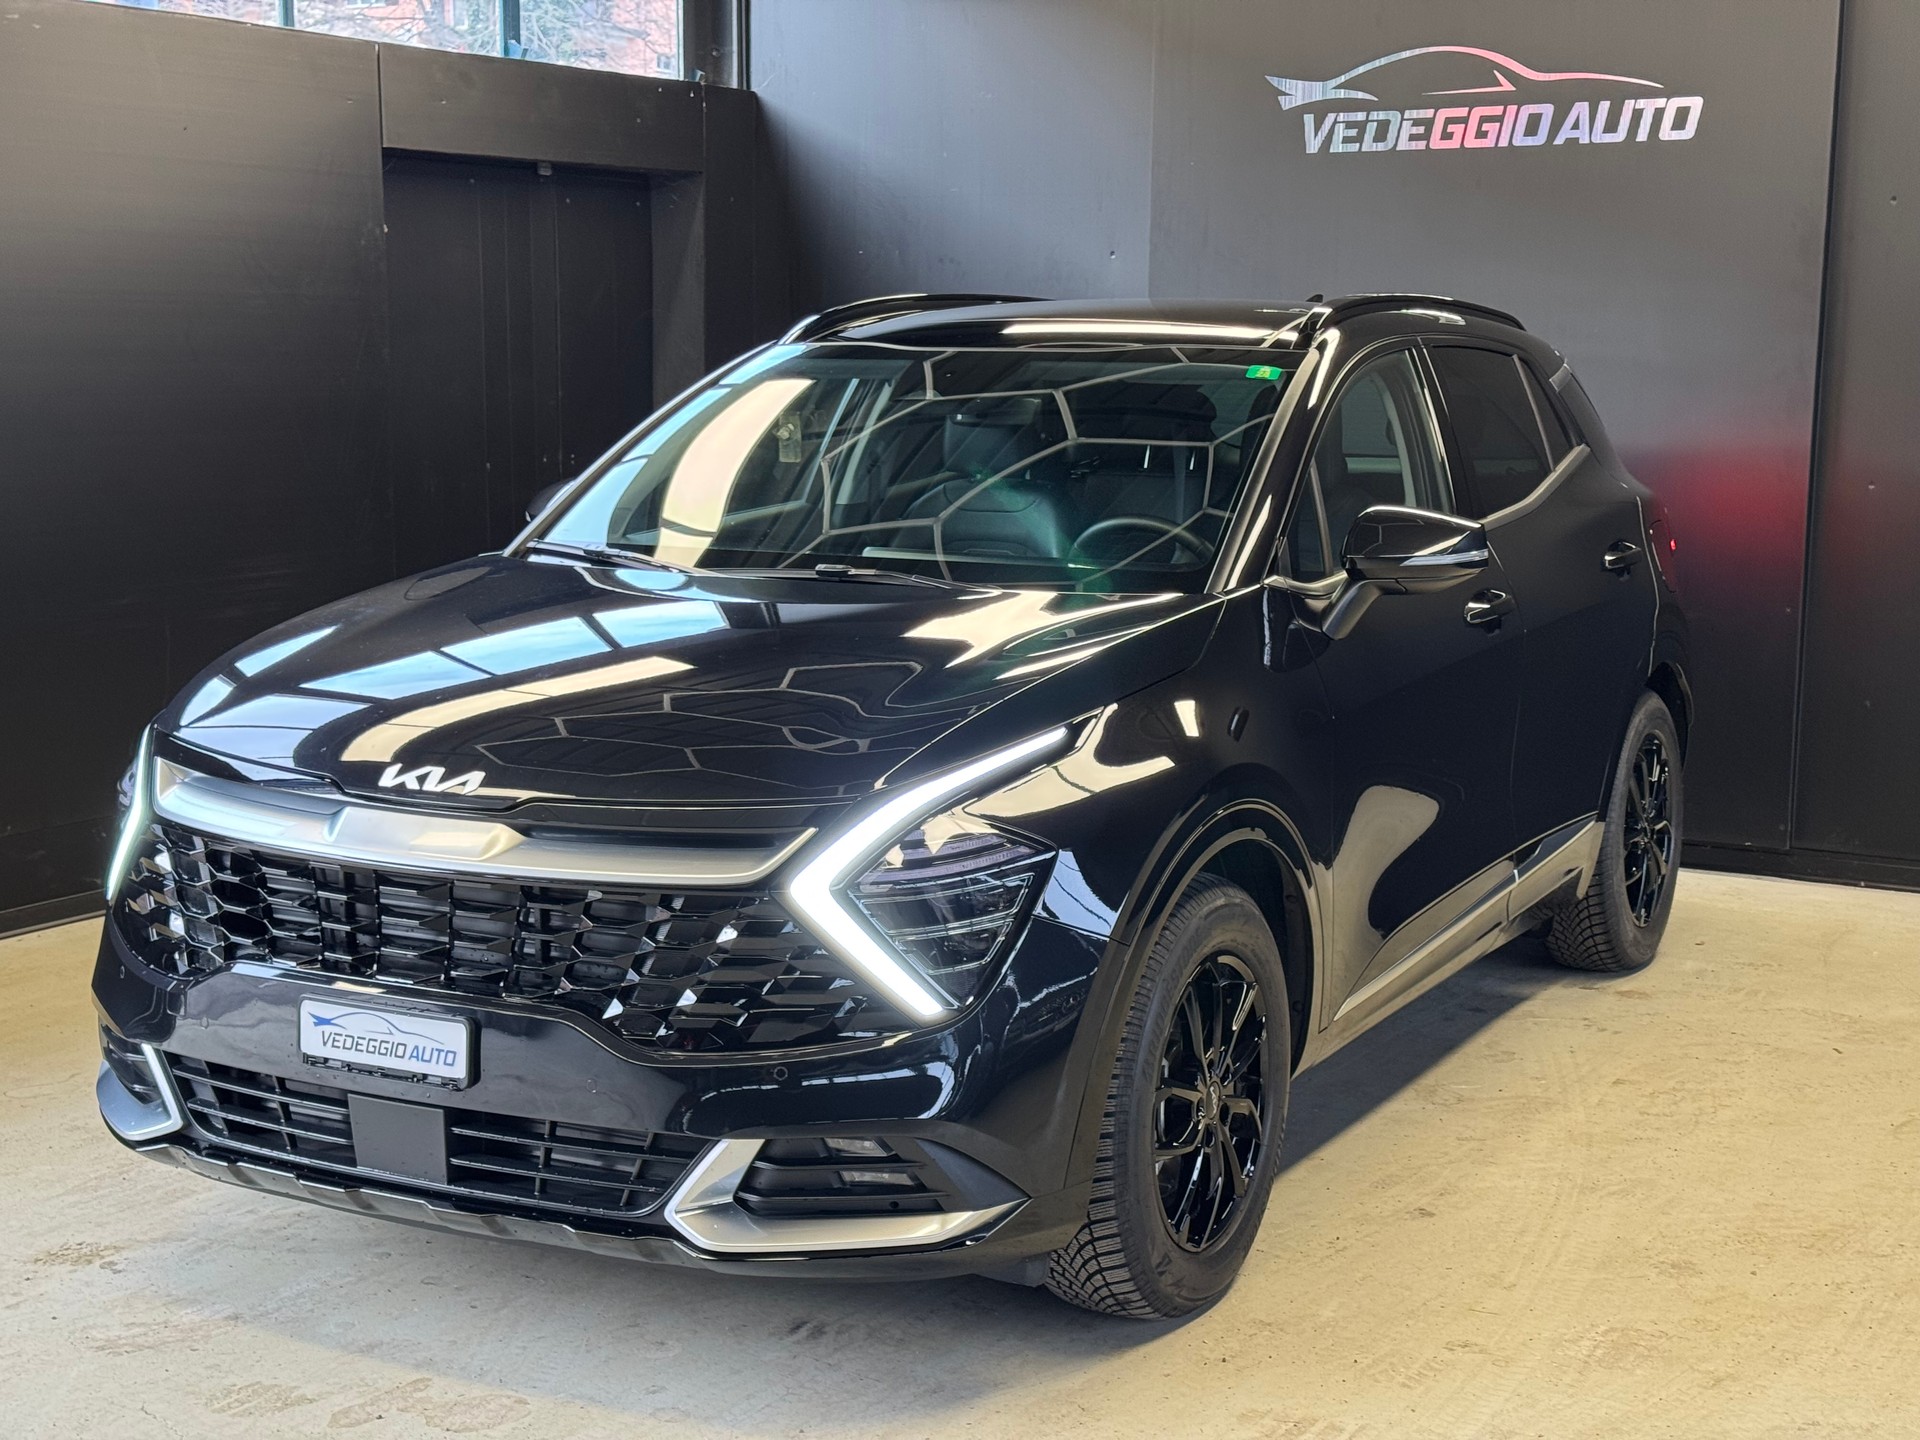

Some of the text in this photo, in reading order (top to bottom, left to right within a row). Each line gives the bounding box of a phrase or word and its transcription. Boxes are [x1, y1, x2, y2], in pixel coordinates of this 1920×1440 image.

[1303, 96, 1704, 154] VEDEGGIO AUTO
[378, 763, 486, 795] KIA
[321, 1030, 457, 1067] VEDEGGIO AUTO
